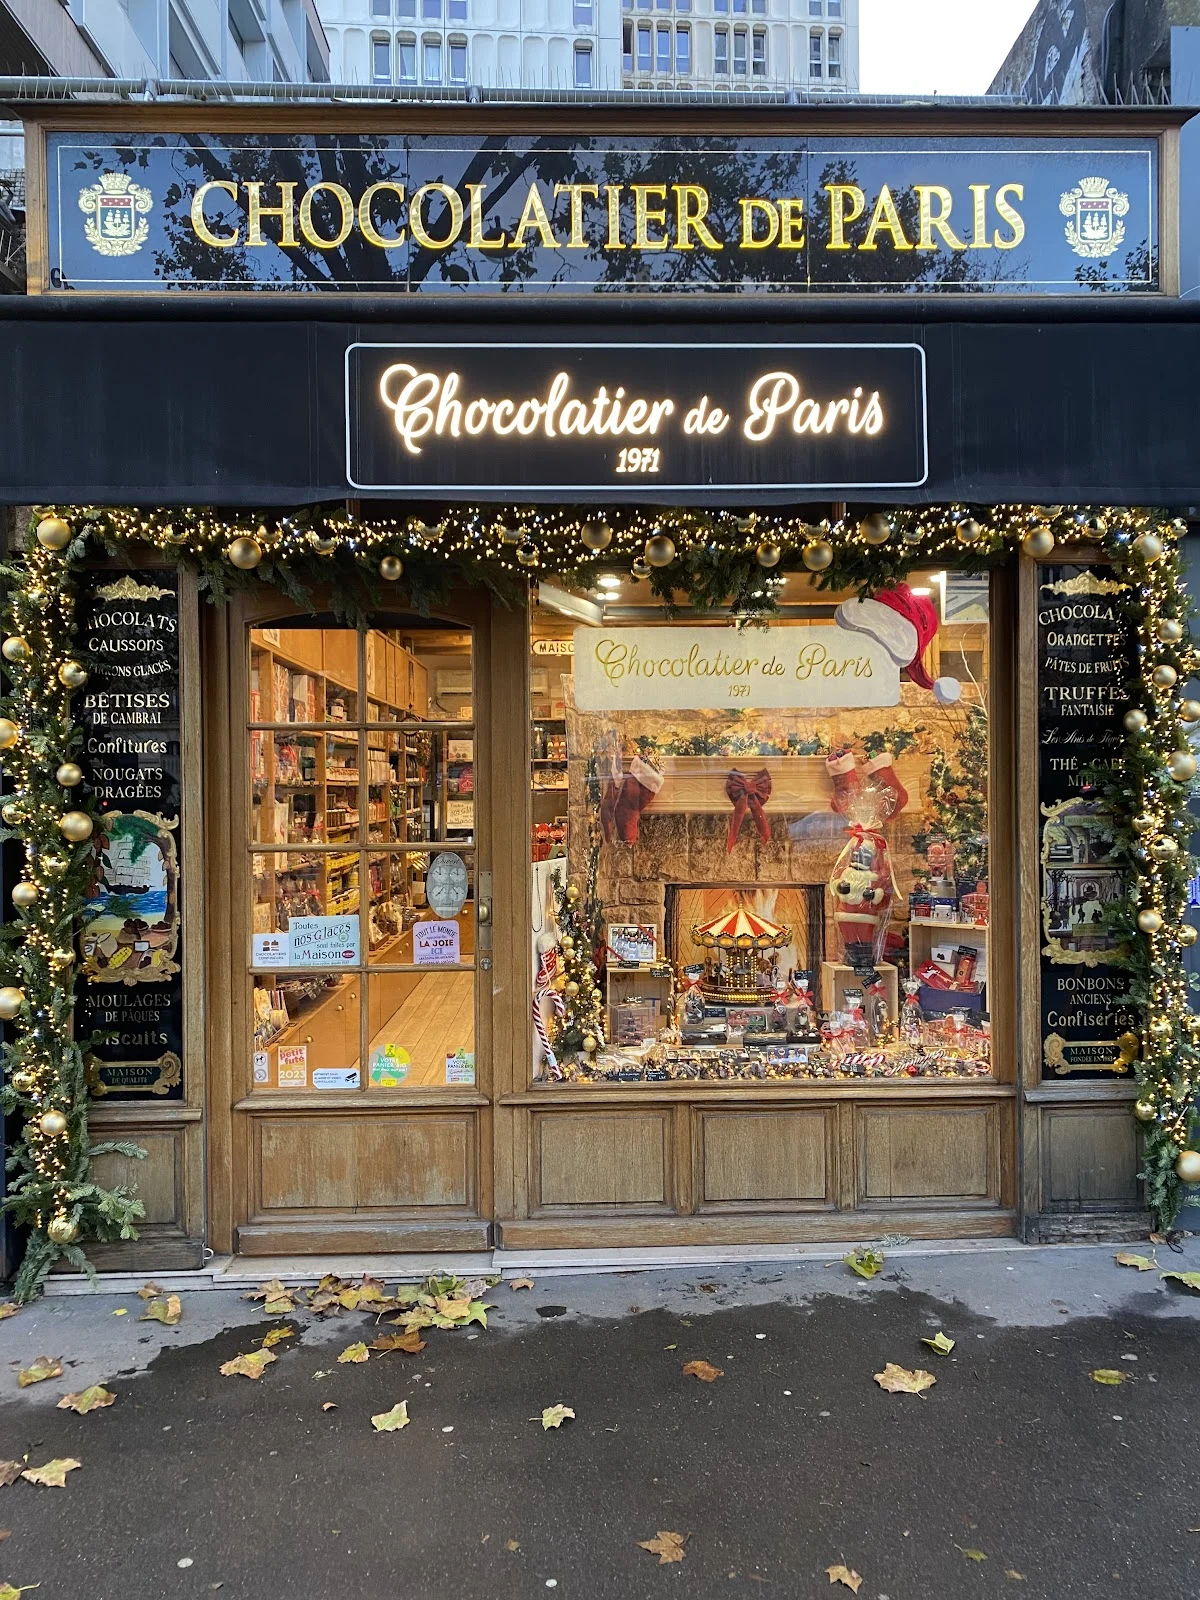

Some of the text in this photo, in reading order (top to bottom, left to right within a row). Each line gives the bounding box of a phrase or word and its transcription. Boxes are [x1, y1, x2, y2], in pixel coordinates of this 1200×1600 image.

[190, 181, 1026, 251] CHOCOLATIER DE PARIS
[379, 363, 884, 455] Chocolatier de Paris
[615, 447, 661, 474] 1971
[595, 639, 873, 688] Chocolatier de Paris
[1078, 663, 1092, 674] DE
[1094, 657, 1130, 673] FRUITS
[728, 684, 751, 697] 1971
[1044, 686, 1130, 700] TRUFFES
[84, 692, 170, 708] BÊTISES
[1061, 704, 1115, 716] FANTAISIE
[93, 711, 161, 725] DE CAMBRAI
[88, 737, 167, 754] Confitures
[1050, 756, 1079, 770] THÉ
[93, 768, 163, 780] NOUGATS
[94, 783, 162, 798] DRAGÉES
[293, 922, 319, 930] Toutes
[294, 934, 312, 947] nos
[432, 939, 454, 947] JOIE
[294, 952, 302, 960] la
[301, 949, 341, 960] Maison
[1057, 978, 1125, 990] BONBONS
[87, 993, 171, 1007] MOULAGES
[1070, 993, 1112, 1005] ANCIENS
[105, 1009, 160, 1023] DE PÂQUES
[280, 1048, 304, 1060] petit
[1070, 1046, 1113, 1055] MAISON
[284, 1055, 305, 1065] futé
[107, 1067, 153, 1076] MAISON
[280, 1070, 305, 1079] 2023
